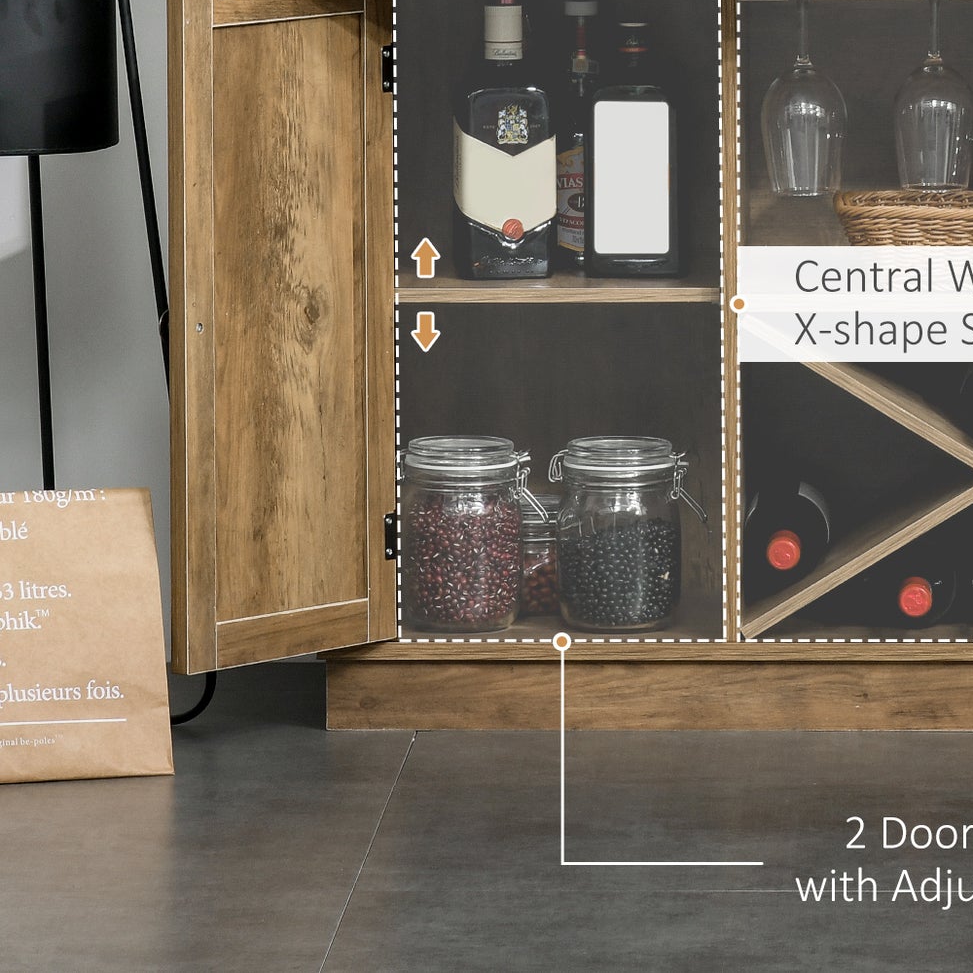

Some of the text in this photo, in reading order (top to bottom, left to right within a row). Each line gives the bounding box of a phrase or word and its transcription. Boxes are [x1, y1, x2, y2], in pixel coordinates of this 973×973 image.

[18, 579, 72, 600] litres.
[0, 678, 125, 709] plusieurs fois.
